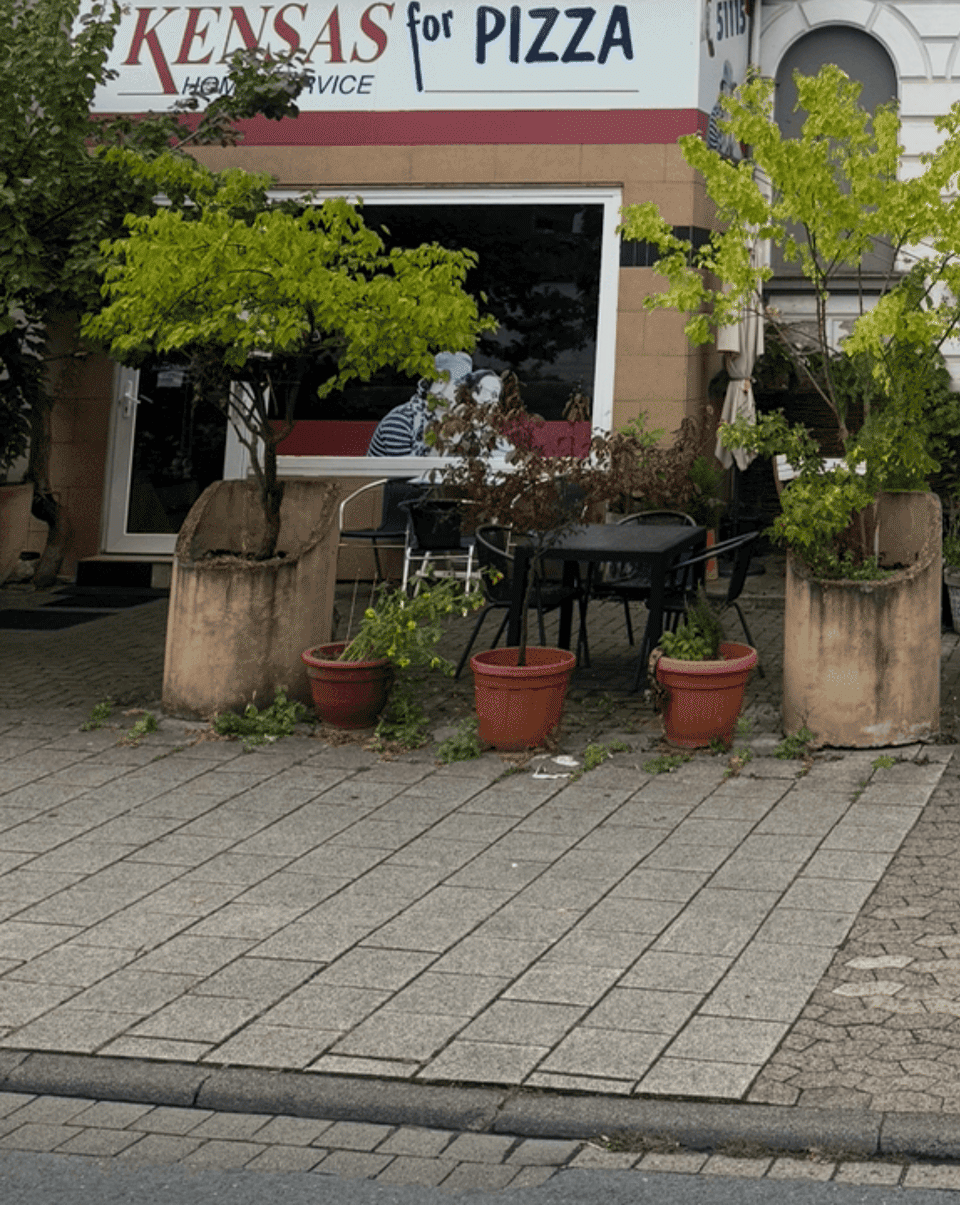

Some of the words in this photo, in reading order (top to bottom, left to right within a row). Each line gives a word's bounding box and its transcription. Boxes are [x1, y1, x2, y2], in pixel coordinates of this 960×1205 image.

[120, 2, 395, 95] KENSAS
[407, 1, 453, 92] for
[476, 5, 634, 65] PIZZA
[181, 76, 248, 95] HOM
[281, 75, 375, 95] RVICE
